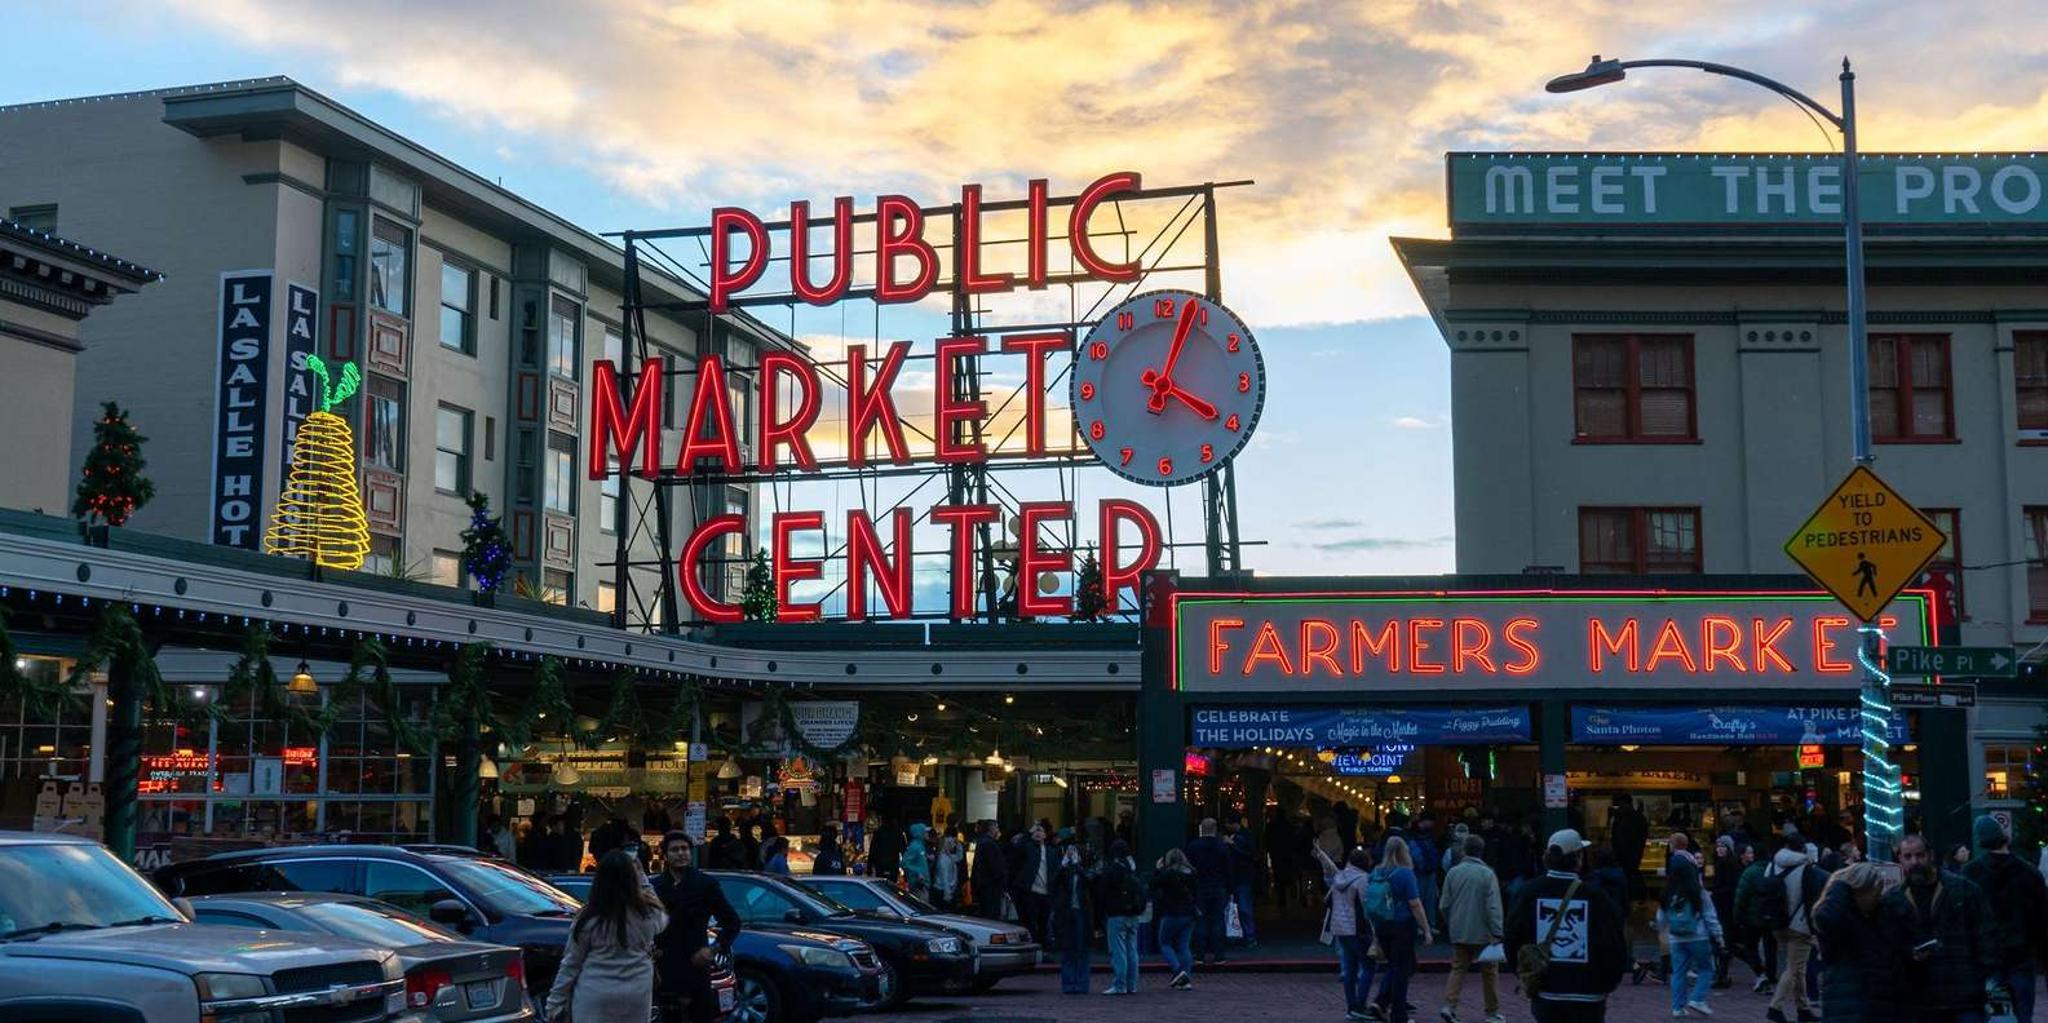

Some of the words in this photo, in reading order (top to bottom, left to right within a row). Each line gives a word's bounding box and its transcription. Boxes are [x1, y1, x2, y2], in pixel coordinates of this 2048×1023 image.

[1484, 165, 1667, 214] MEET
[1711, 165, 1841, 213] THE
[1894, 164, 2042, 214] PRO
[709, 171, 1142, 314] PUBLIC
[228, 283, 261, 329] LA
[291, 290, 311, 339] LA
[1155, 300, 1173, 318] 12
[1118, 312, 1132, 329] 11
[1200, 308, 1208, 325] 1
[1090, 342, 1107, 358] 10
[1227, 334, 1239, 351] 2
[1238, 373, 1250, 392] 3
[226, 337, 260, 457] SALLE
[1081, 384, 1094, 400] 9
[589, 331, 1073, 481] MARKET
[1090, 421, 1104, 439] 8
[1225, 414, 1239, 431] 4
[1120, 448, 1133, 465] 7
[1200, 444, 1213, 462] 5
[1158, 458, 1172, 475] 6
[1839, 492, 1886, 508] YIELD
[220, 475, 252, 545] HOT
[1853, 512, 1872, 526] TO
[1805, 527, 1923, 548] PEDESTRIANS
[679, 498, 1163, 622] CENTER
[1210, 619, 1539, 675] FARMERS
[1895, 649, 1944, 671] Pike
[1957, 655, 1974, 671] Pl
[1196, 710, 1289, 723] CELEBRATE
[1787, 707, 1805, 720] AT
[1810, 707, 1847, 720] PIKE
[1327, 721, 1360, 743] Magic
[1361, 725, 1370, 737] in
[1370, 722, 1382, 737] the
[1383, 720, 1418, 741] Market
[1453, 718, 1481, 733] Figgy
[1481, 716, 1521, 729] Pudding
[1586, 724, 1619, 735] Santa
[1621, 724, 1661, 735] Photos
[1838, 726, 1904, 739] MAET
[1197, 728, 1232, 742] THE
[1233, 728, 1315, 742] HOLIDAYS
[1331, 753, 1405, 766] VIEWPOINT
